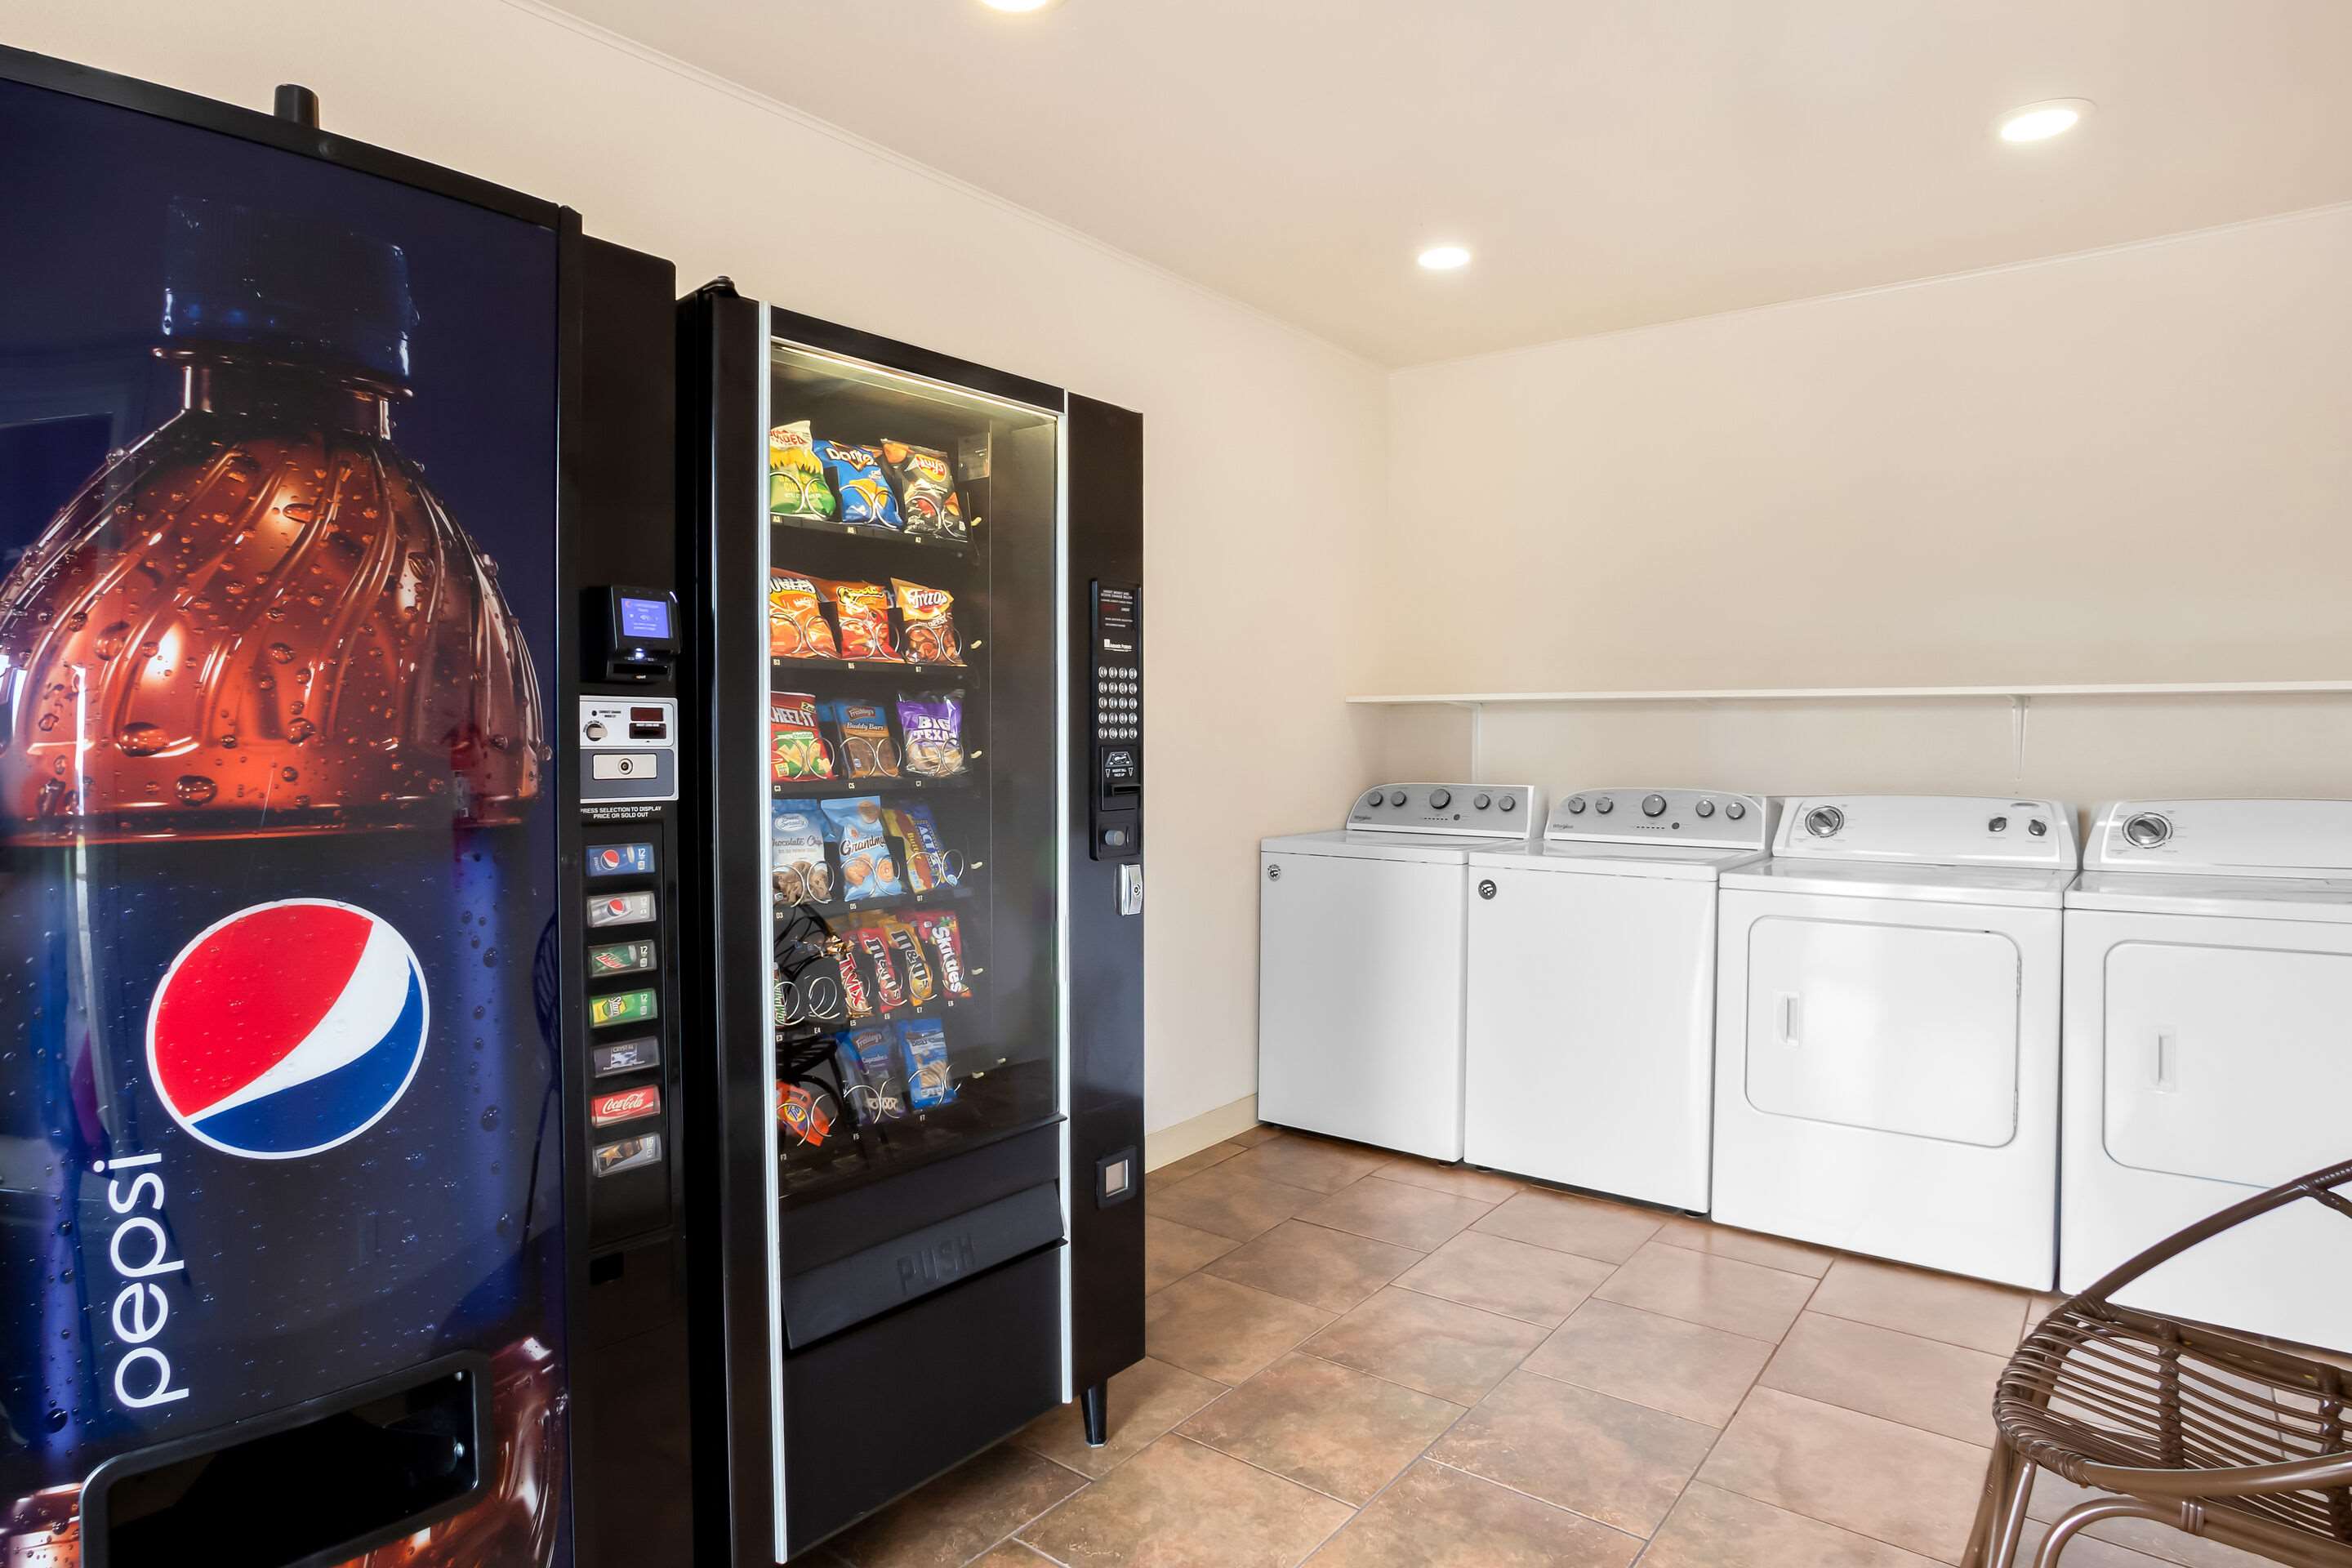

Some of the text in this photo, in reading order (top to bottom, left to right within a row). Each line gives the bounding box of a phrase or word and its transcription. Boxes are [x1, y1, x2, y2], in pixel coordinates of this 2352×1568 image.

[846, 722, 868, 733] Buddy
[917, 715, 952, 732] BIG
[639, 946, 648, 954] 12
[931, 926, 963, 993] Skittles
[93, 1152, 189, 1410] pepsi
[897, 1232, 977, 1295] PUSH
